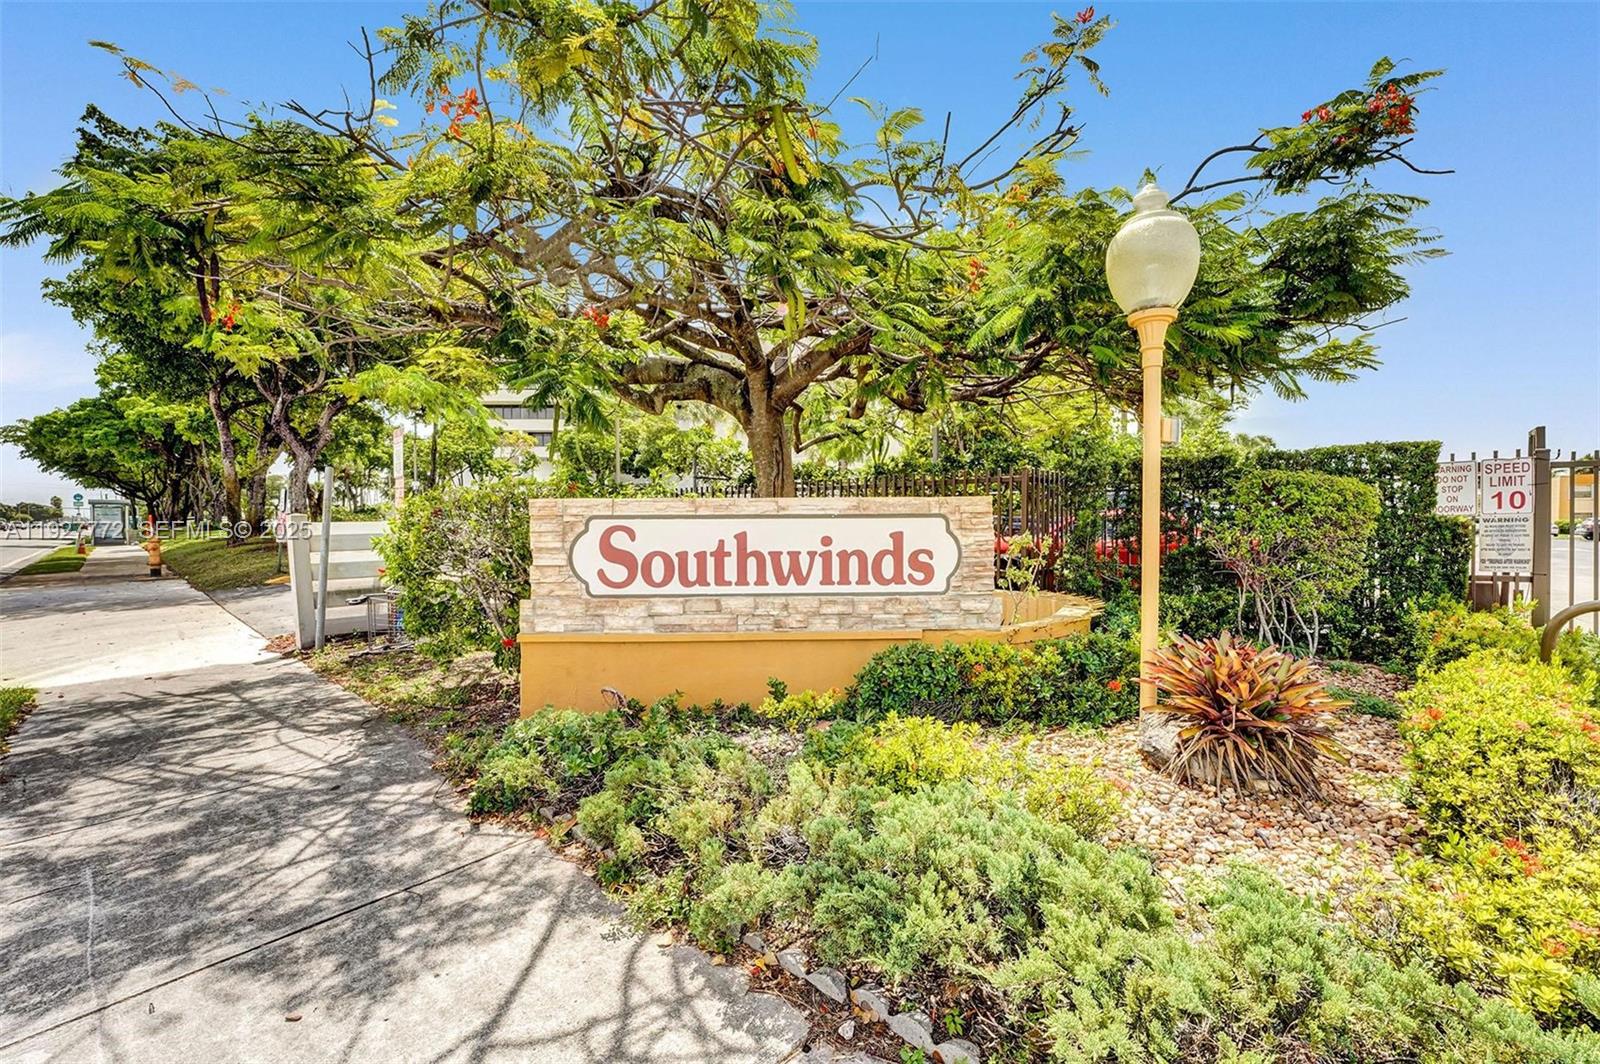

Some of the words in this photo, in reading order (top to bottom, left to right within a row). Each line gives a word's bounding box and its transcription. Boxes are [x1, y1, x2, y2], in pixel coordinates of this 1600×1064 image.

[1437, 464, 1472, 474] ARNING
[1484, 461, 1531, 475] SPEED
[1450, 475, 1468, 484] NOT
[1489, 475, 1526, 488] LIMIT
[1441, 485, 1464, 494] STOP
[1446, 495, 1459, 504] ON
[1491, 490, 1526, 510] 10
[1435, 504, 1474, 514] OORWAY
[1482, 516, 1530, 524] WARNING
[597, 524, 935, 590] Southwinds
